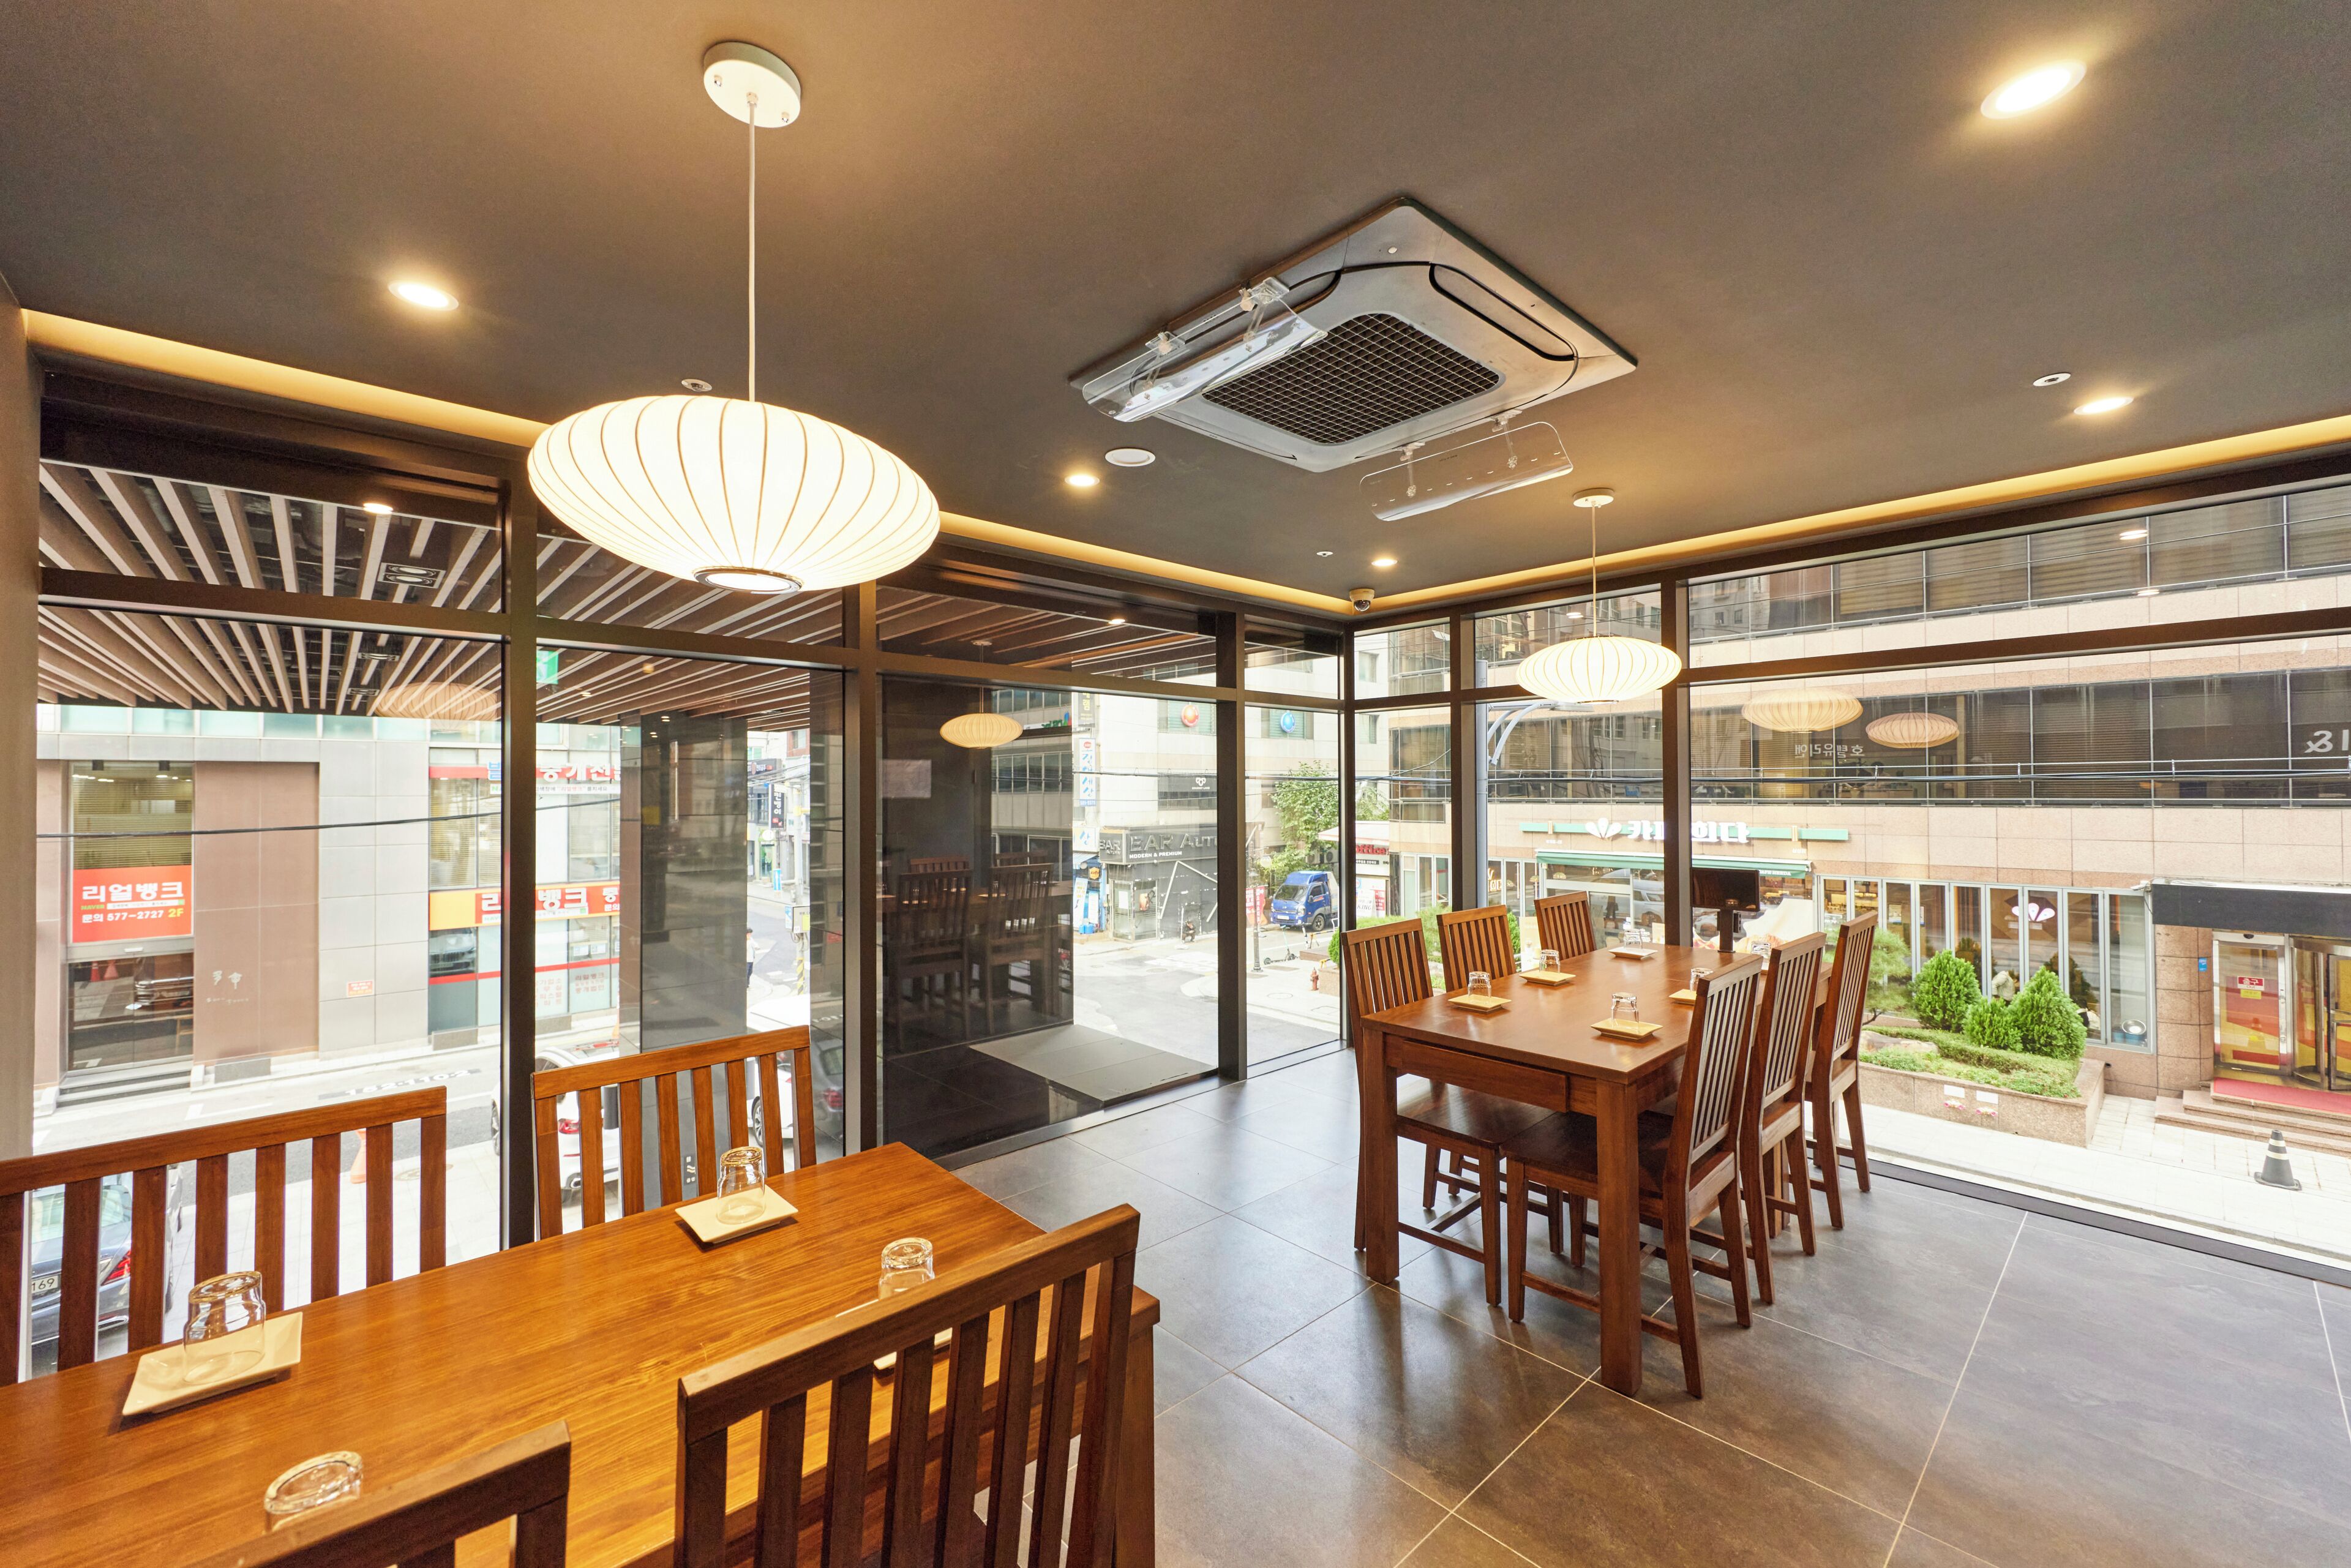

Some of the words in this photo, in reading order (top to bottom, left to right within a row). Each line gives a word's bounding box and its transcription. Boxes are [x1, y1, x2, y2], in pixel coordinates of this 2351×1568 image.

[82, 882, 184, 902] 리얼뱅크
[82, 913, 103, 923] 문의
[107, 910, 164, 921] 577-2727
[168, 908, 184, 918] 2F
